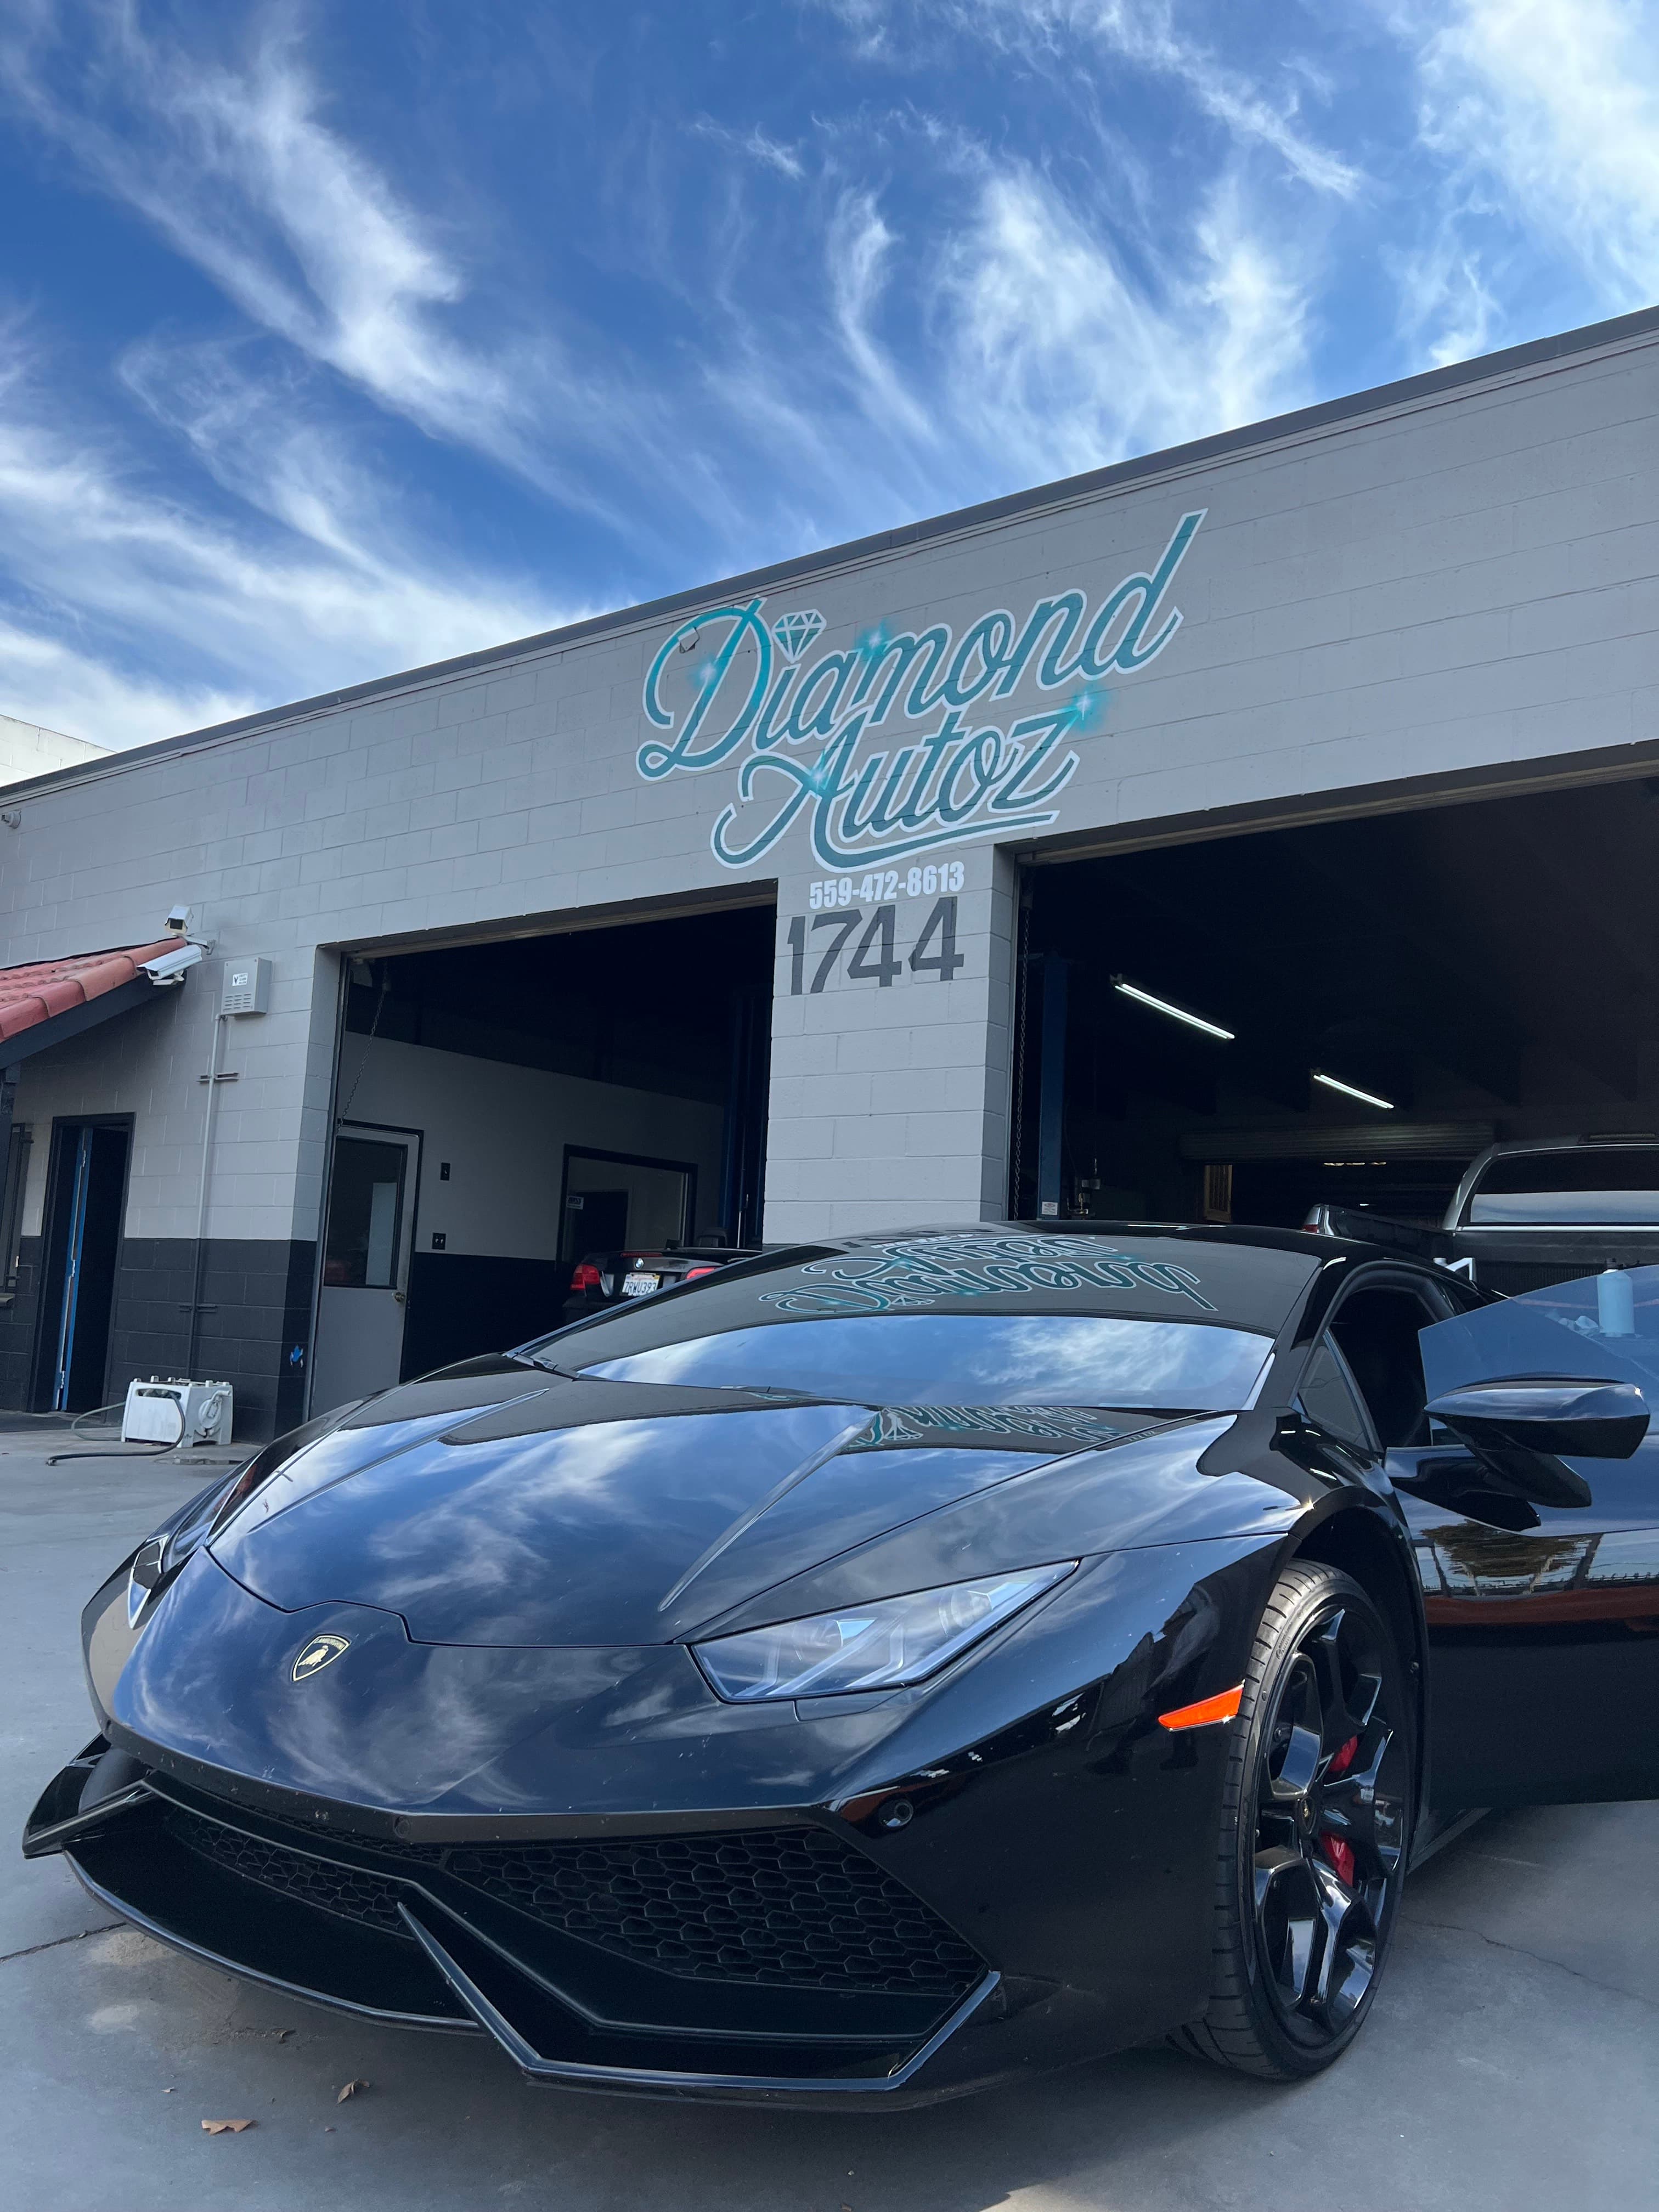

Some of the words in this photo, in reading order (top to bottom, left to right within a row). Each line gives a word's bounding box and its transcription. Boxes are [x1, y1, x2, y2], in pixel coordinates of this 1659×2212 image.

[636, 507, 1208, 780] Diamond
[710, 703, 1084, 873] Autoz
[787, 895, 965, 996] 1744
[809, 861, 965, 910] 559-472-8613
